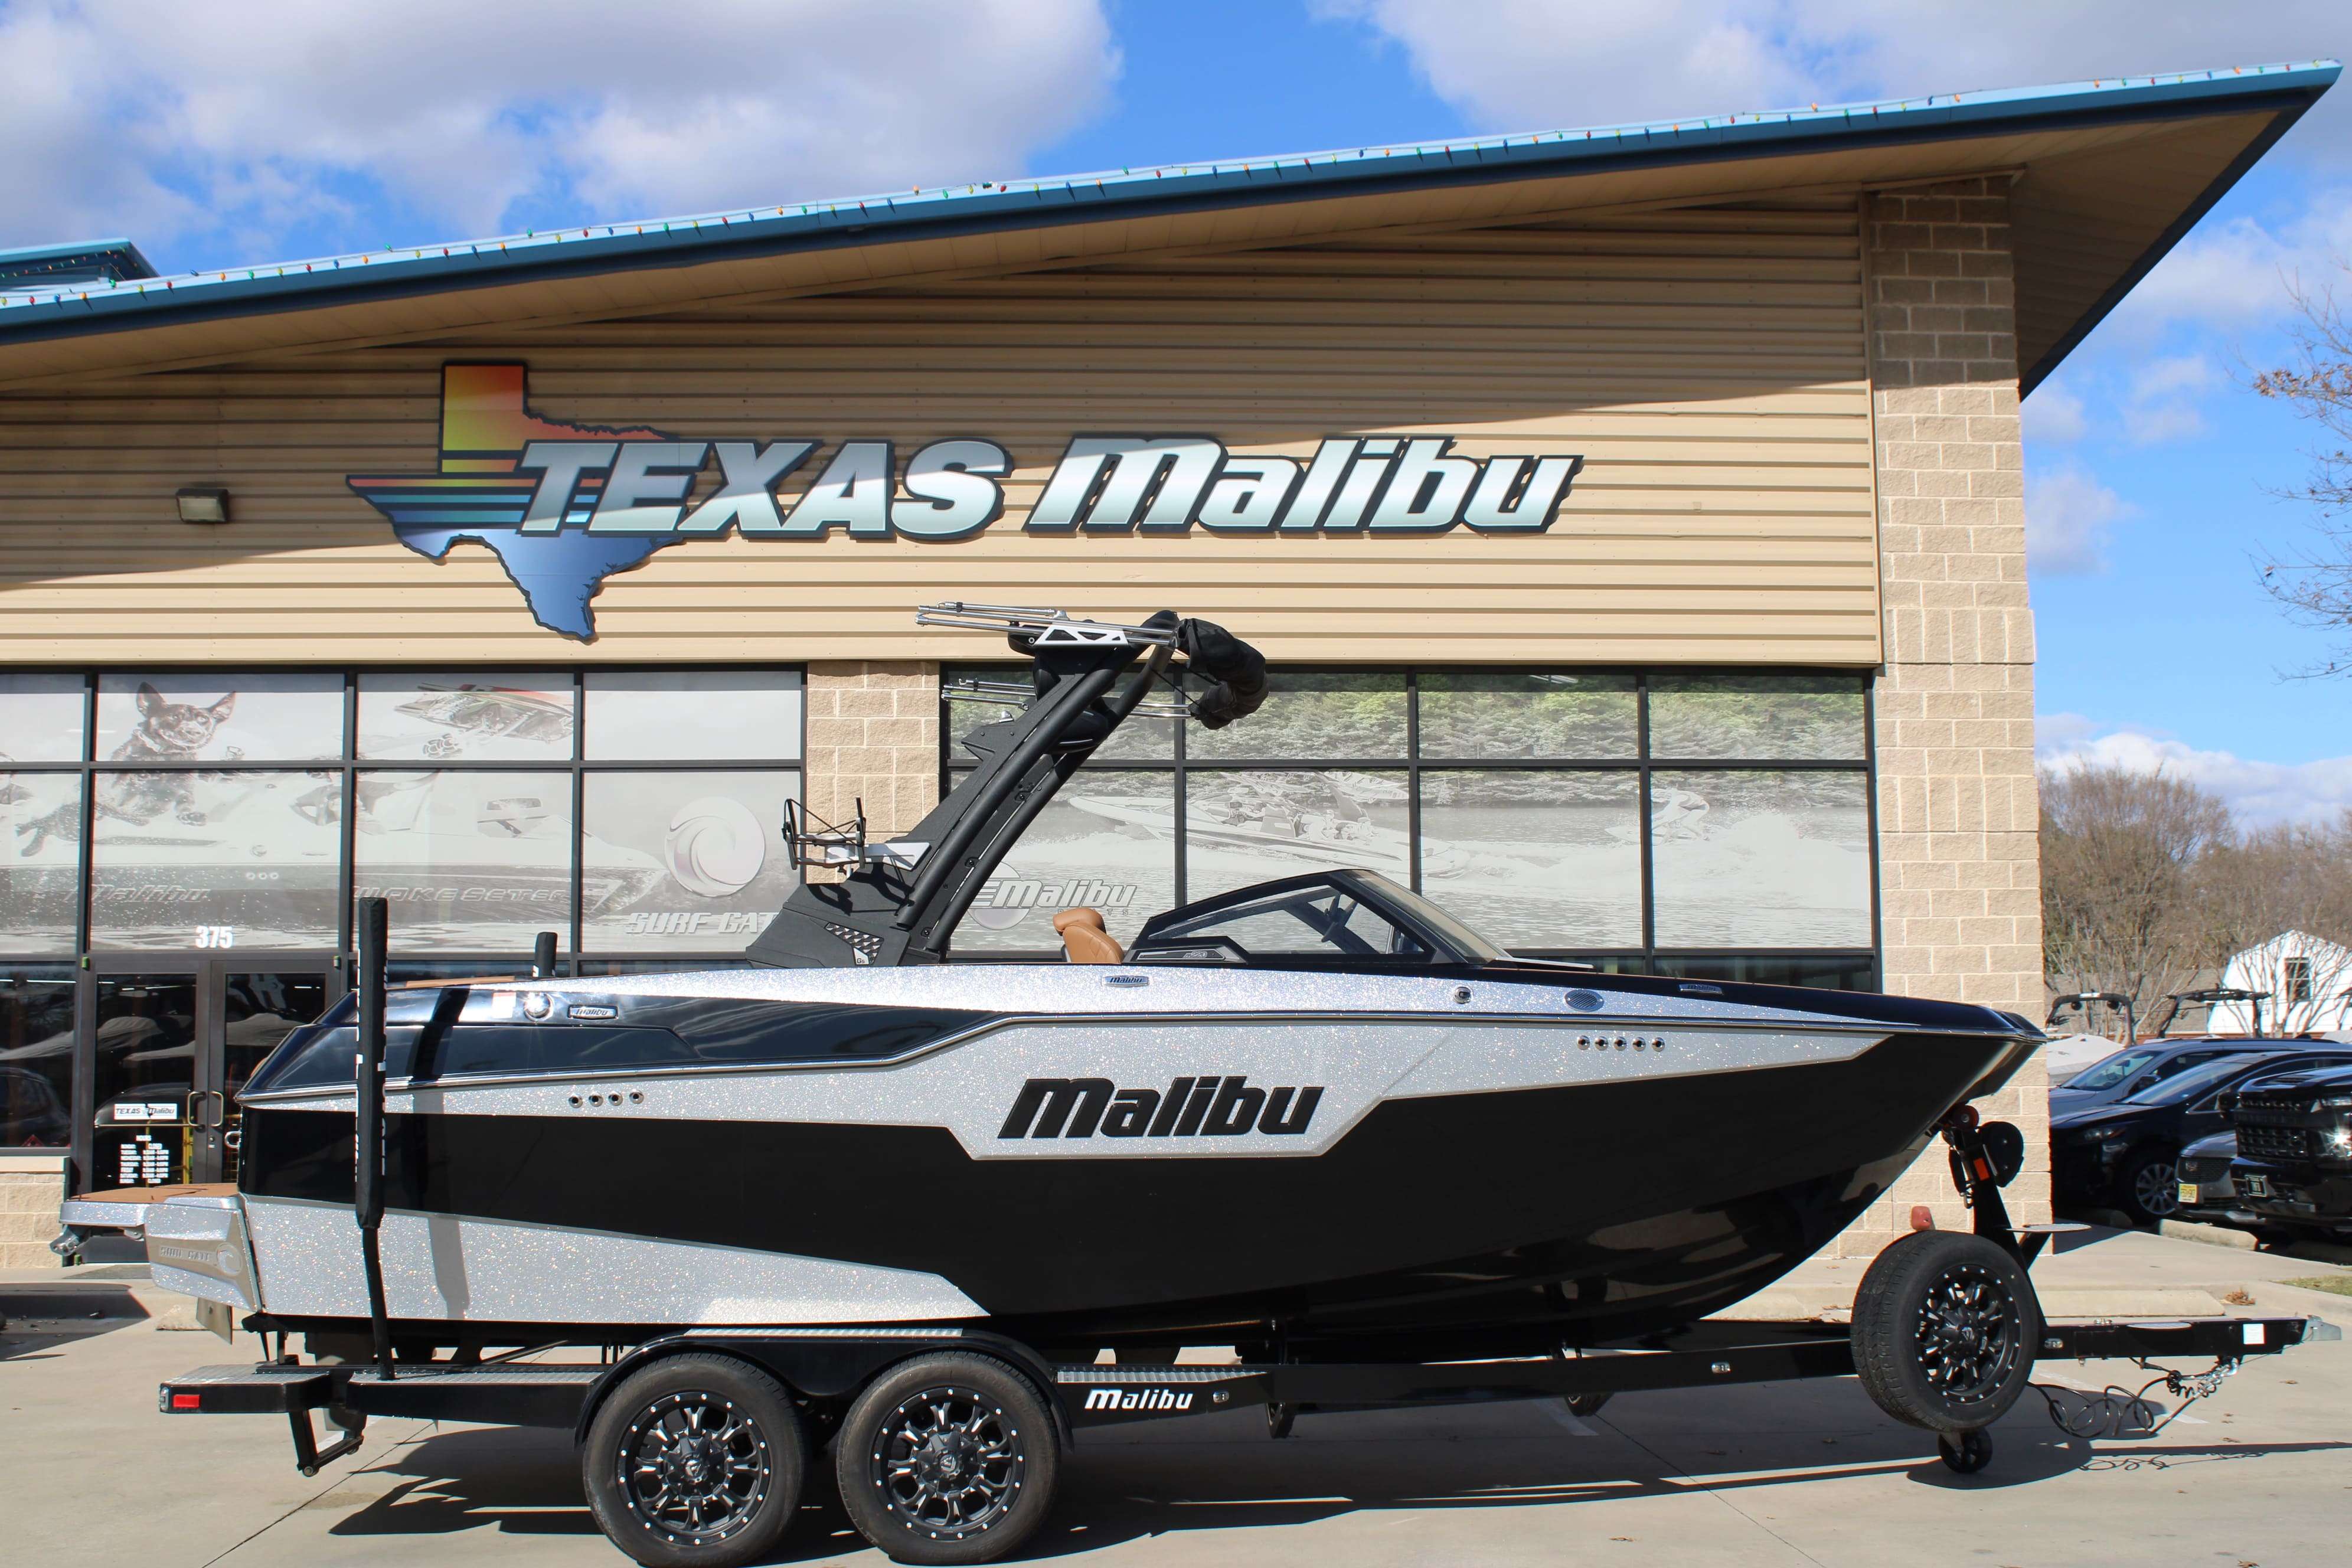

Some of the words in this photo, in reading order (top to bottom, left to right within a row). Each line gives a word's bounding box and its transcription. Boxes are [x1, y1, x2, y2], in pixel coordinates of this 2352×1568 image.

[520, 440, 1012, 538] TEXAS
[1023, 435, 1583, 533] Malibu
[991, 879, 1137, 907] Malibu
[626, 912, 712, 933] SURF
[718, 912, 780, 933] GAT
[195, 925, 233, 948] 375
[997, 1076, 1324, 1139] Malibu
[1084, 1389, 1194, 1410] Malibu
